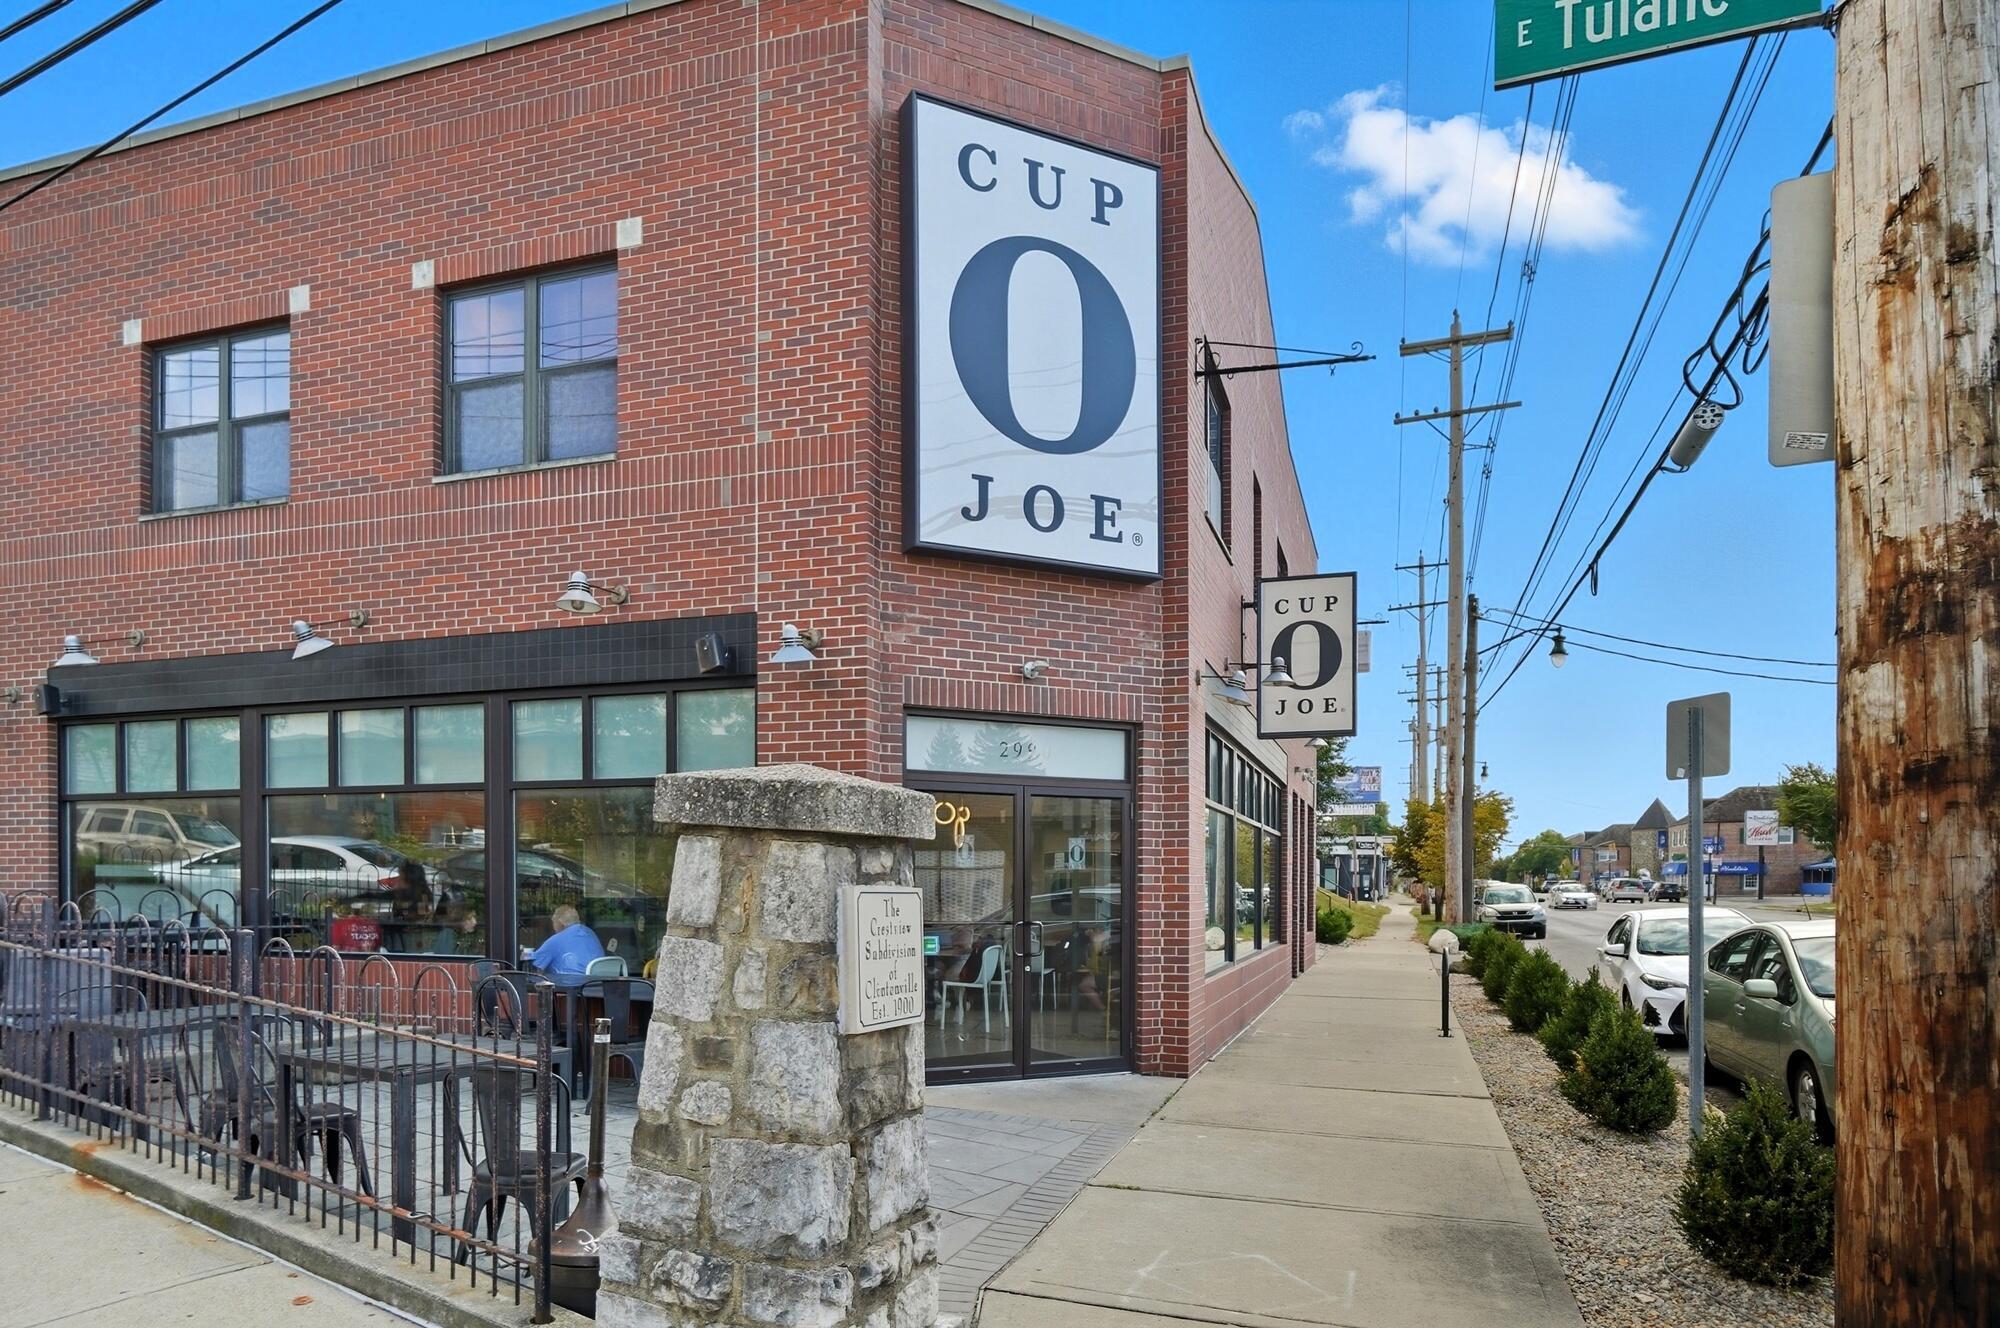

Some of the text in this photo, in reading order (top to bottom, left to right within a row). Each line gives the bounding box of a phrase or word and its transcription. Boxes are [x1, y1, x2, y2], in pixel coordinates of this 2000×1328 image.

[1517, 19, 1533, 48] E
[957, 142, 1124, 226] CUP
[949, 235, 1137, 455] O
[1274, 596, 1338, 614] CUP
[1270, 620, 1343, 690] O
[1275, 698, 1337, 715] JOE
[884, 897, 900, 917] The
[870, 917, 912, 937] Crestview
[865, 939, 916, 960] Subdivision
[889, 960, 897, 980] of
[865, 973, 918, 1000] Clintonville
[872, 997, 914, 1020] Est. 1900
